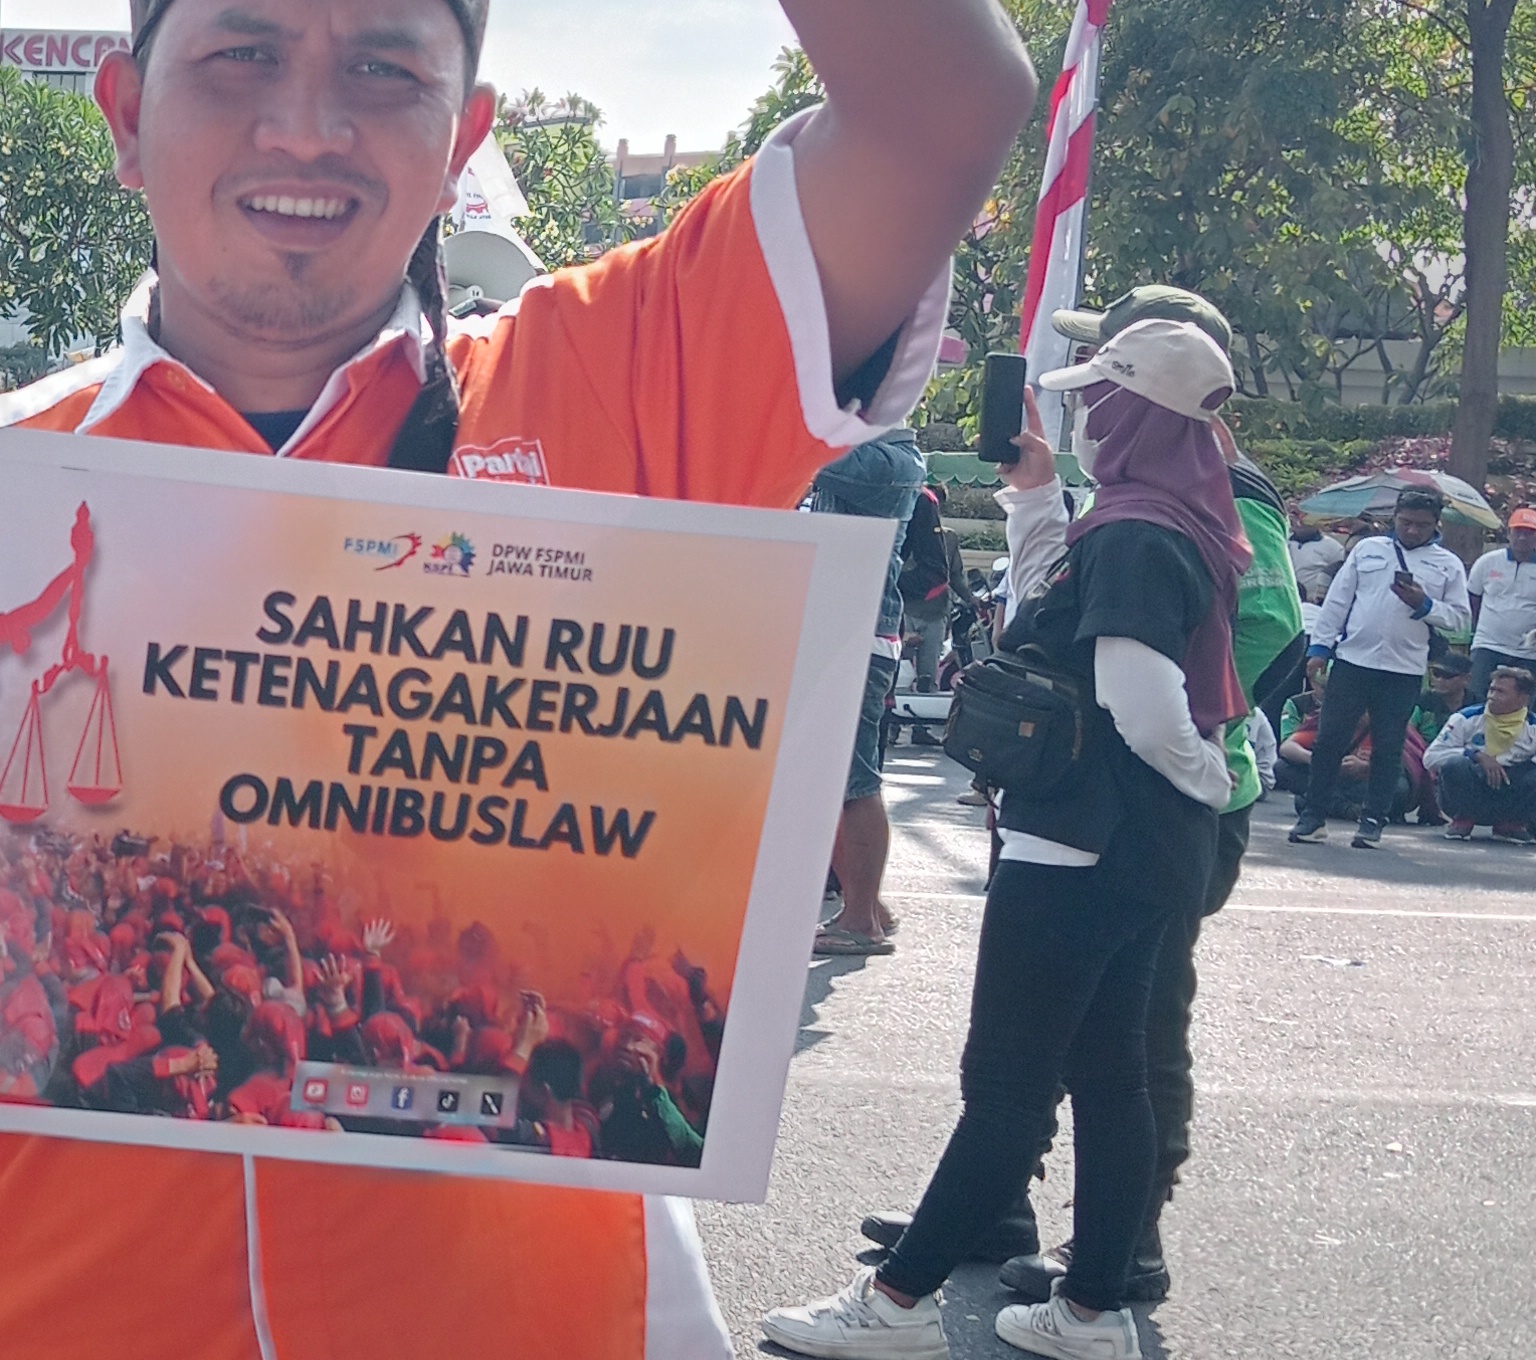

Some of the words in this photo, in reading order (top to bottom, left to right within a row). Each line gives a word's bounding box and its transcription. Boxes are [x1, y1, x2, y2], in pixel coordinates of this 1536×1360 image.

[344, 537, 398, 558] FSPMI
[487, 558, 533, 577] JAWA
[539, 564, 593, 582] TIMUR
[492, 543, 533, 563] DPW
[535, 547, 585, 566] FSPMI
[255, 591, 530, 668] SAHKAN
[544, 618, 675, 679] RUU
[141, 641, 769, 751] KETENAGAKERJAAN
[342, 722, 550, 792] TANPA
[218, 772, 656, 860] OMNIBUSLAW
